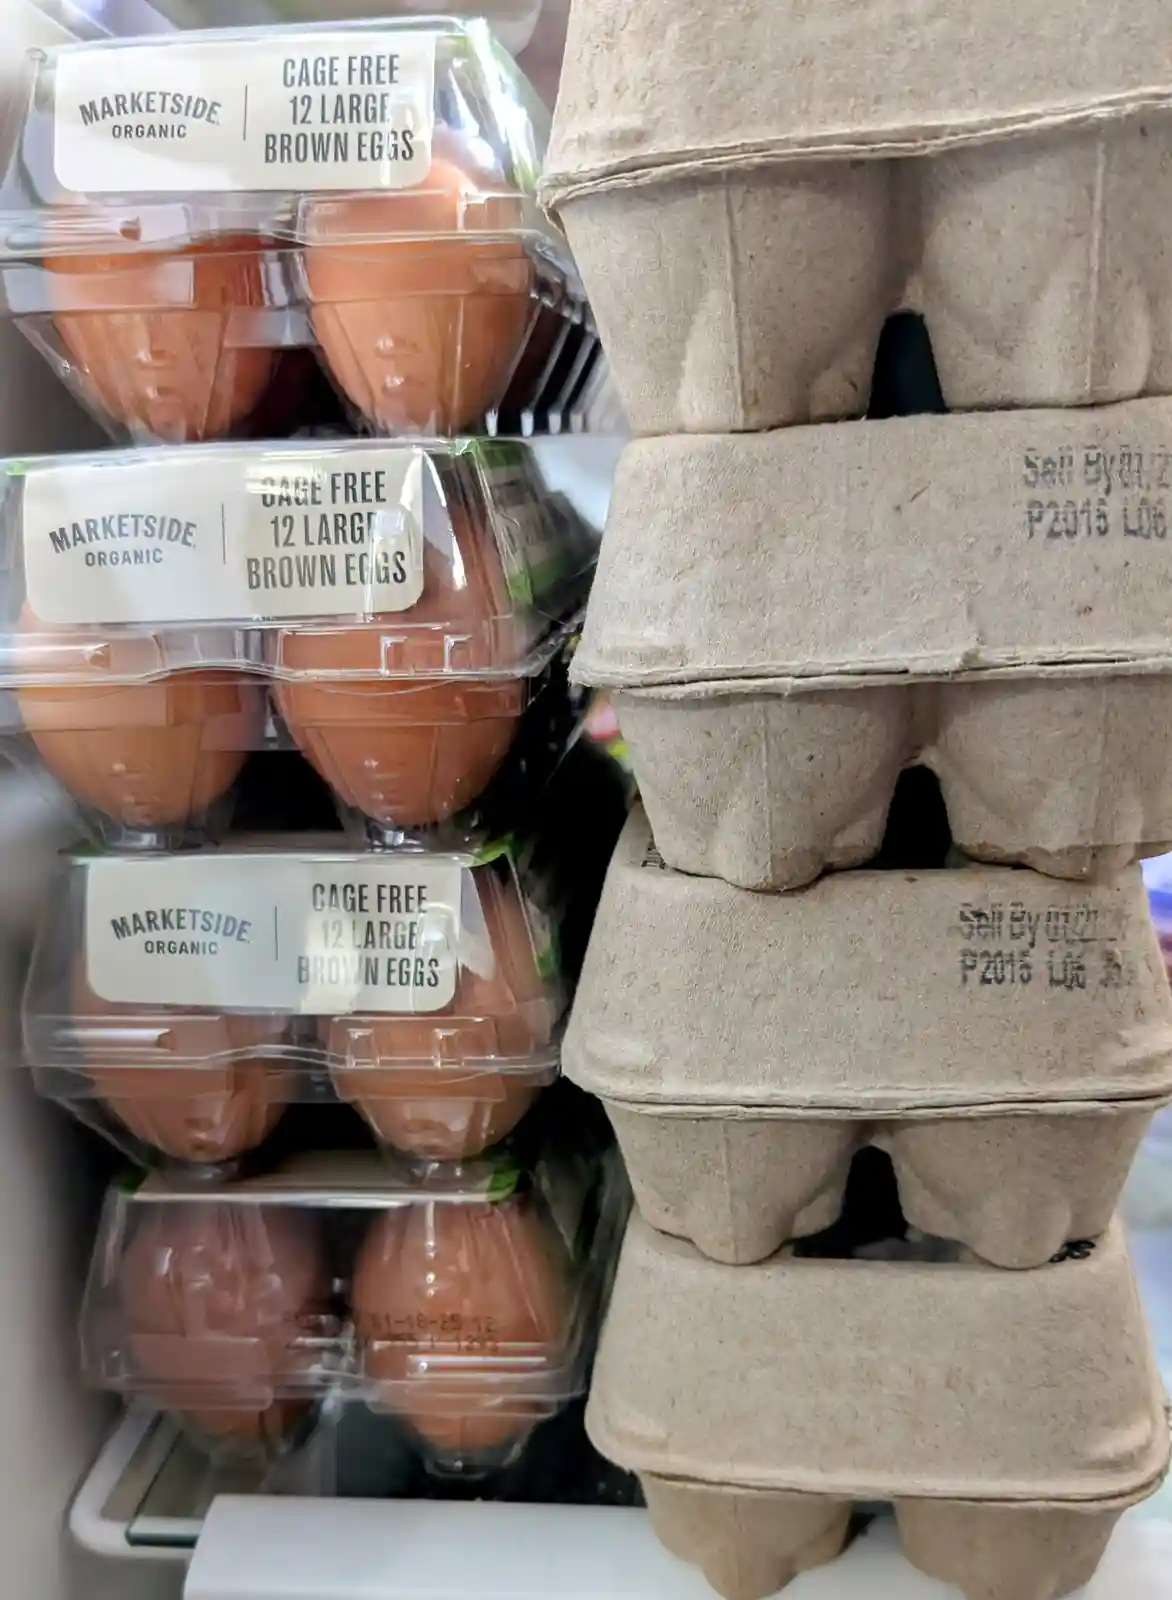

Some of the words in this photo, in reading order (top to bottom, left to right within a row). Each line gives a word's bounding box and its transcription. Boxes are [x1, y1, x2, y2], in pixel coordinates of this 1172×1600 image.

[282, 56, 340, 88] CAGE
[347, 54, 400, 86] FREE
[78, 90, 221, 126] MARKETSIDE
[289, 93, 312, 125] 12
[320, 92, 390, 124] LARGE
[111, 124, 188, 139] ORGANIC
[264, 131, 349, 164] BROWN
[357, 128, 414, 162] EGGS
[331, 470, 387, 505] FREE
[49, 514, 197, 554] MARKETSIDE
[270, 514, 296, 547] 12
[85, 548, 163, 567] ORGANIC
[247, 554, 337, 590] BROWN
[345, 551, 407, 586] EGGS
[312, 883, 370, 912] CAGE
[377, 884, 428, 914] FREE
[110, 908, 252, 942] MARKETSIDE
[321, 919, 343, 949] 12
[352, 920, 418, 950] LARGE
[144, 940, 219, 955] ORGANIC
[297, 955, 379, 986] BROWN
[386, 957, 440, 988] EGGS
